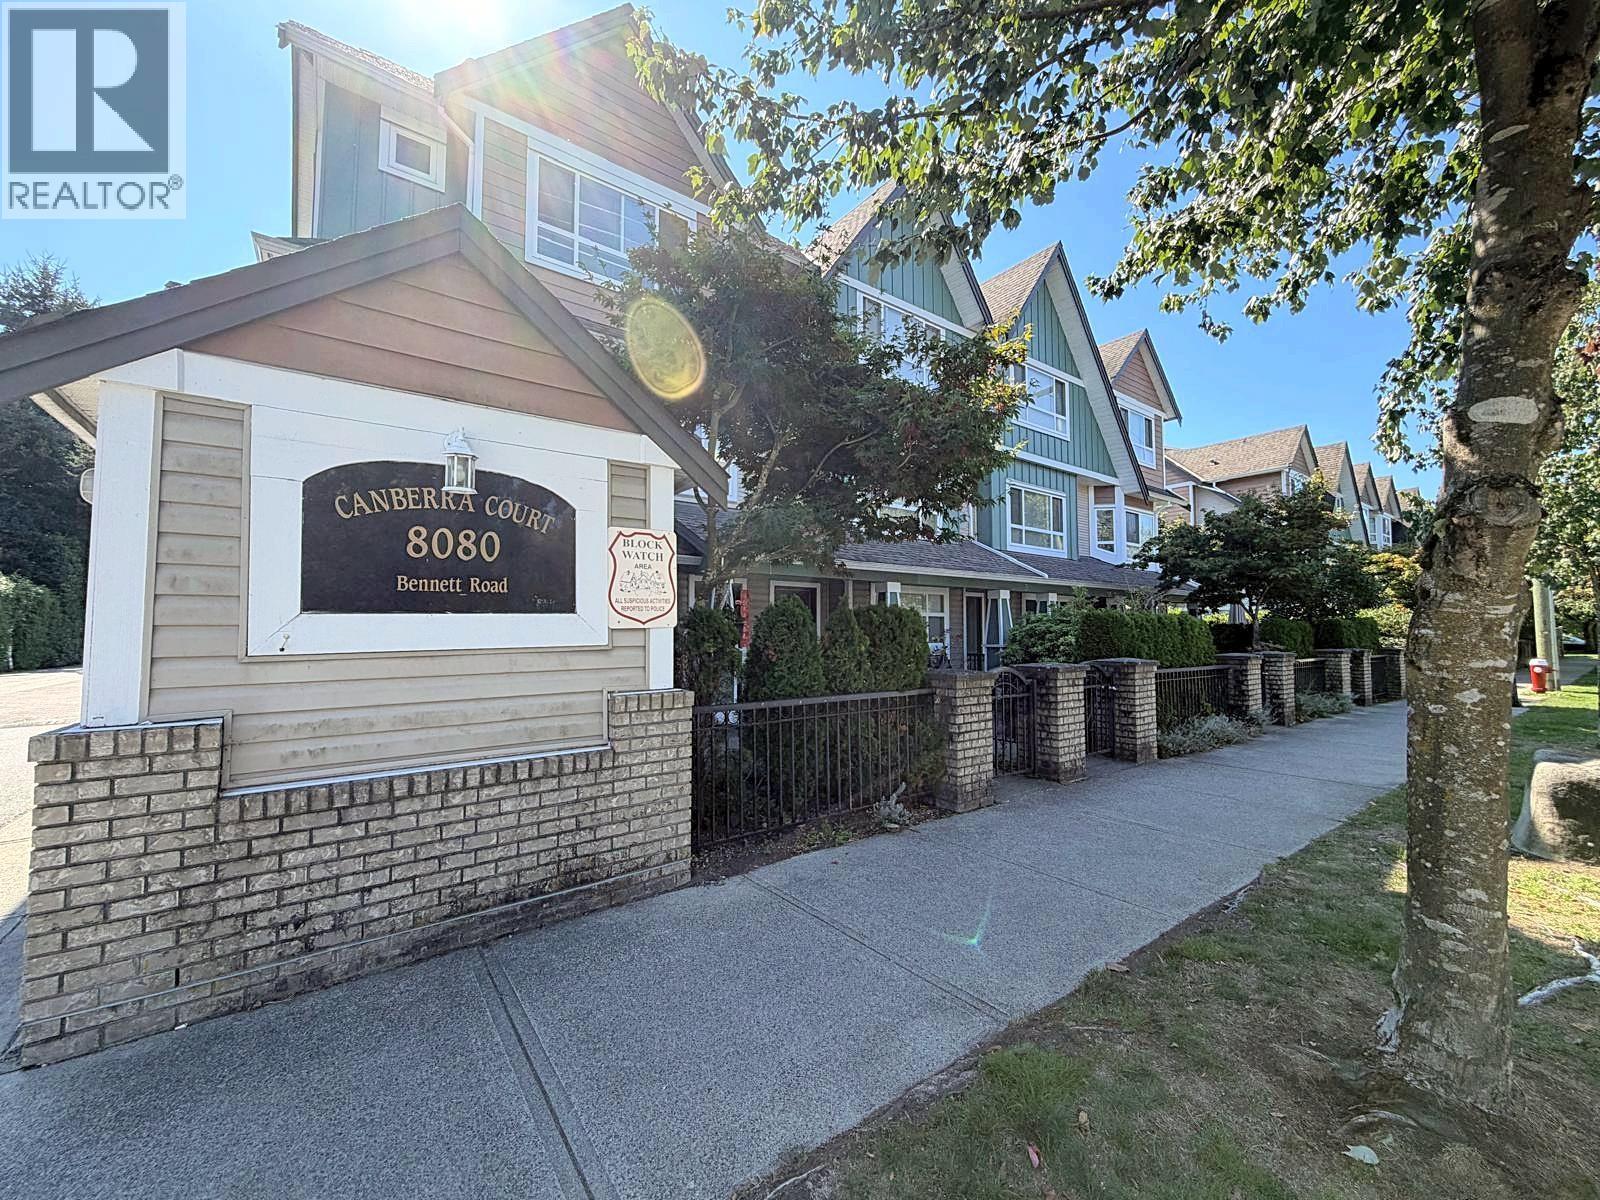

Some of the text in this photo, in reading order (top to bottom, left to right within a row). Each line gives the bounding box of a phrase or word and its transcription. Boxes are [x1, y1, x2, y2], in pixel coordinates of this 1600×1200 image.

[334, 487, 556, 535] CANBERRA COURT
[406, 525, 501, 562] 8080
[622, 538, 663, 550] BLOCK
[622, 550, 664, 562] WATCH
[396, 575, 509, 593] Bennett Road
